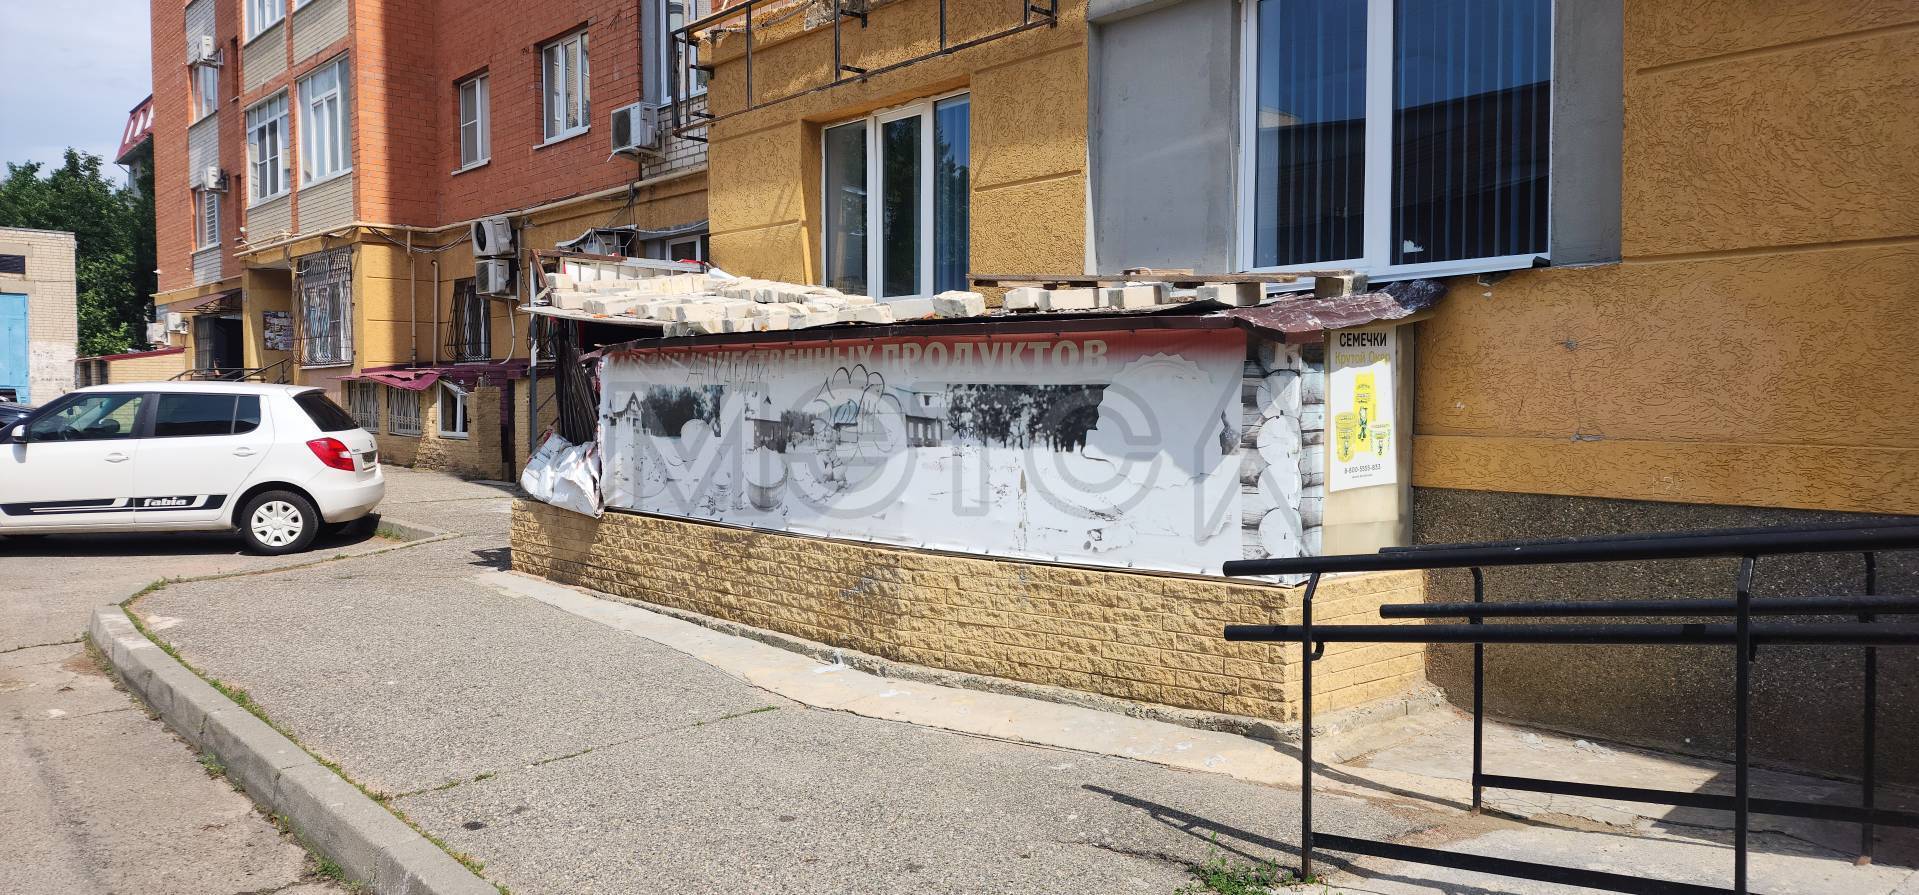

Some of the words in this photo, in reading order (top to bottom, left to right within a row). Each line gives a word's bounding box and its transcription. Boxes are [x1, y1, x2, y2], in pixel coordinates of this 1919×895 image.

[1340, 332, 1387, 347] СЕМЕЧКИ
[881, 340, 1108, 374] ПРОДУКТОВ
[143, 496, 186, 507] fabia
